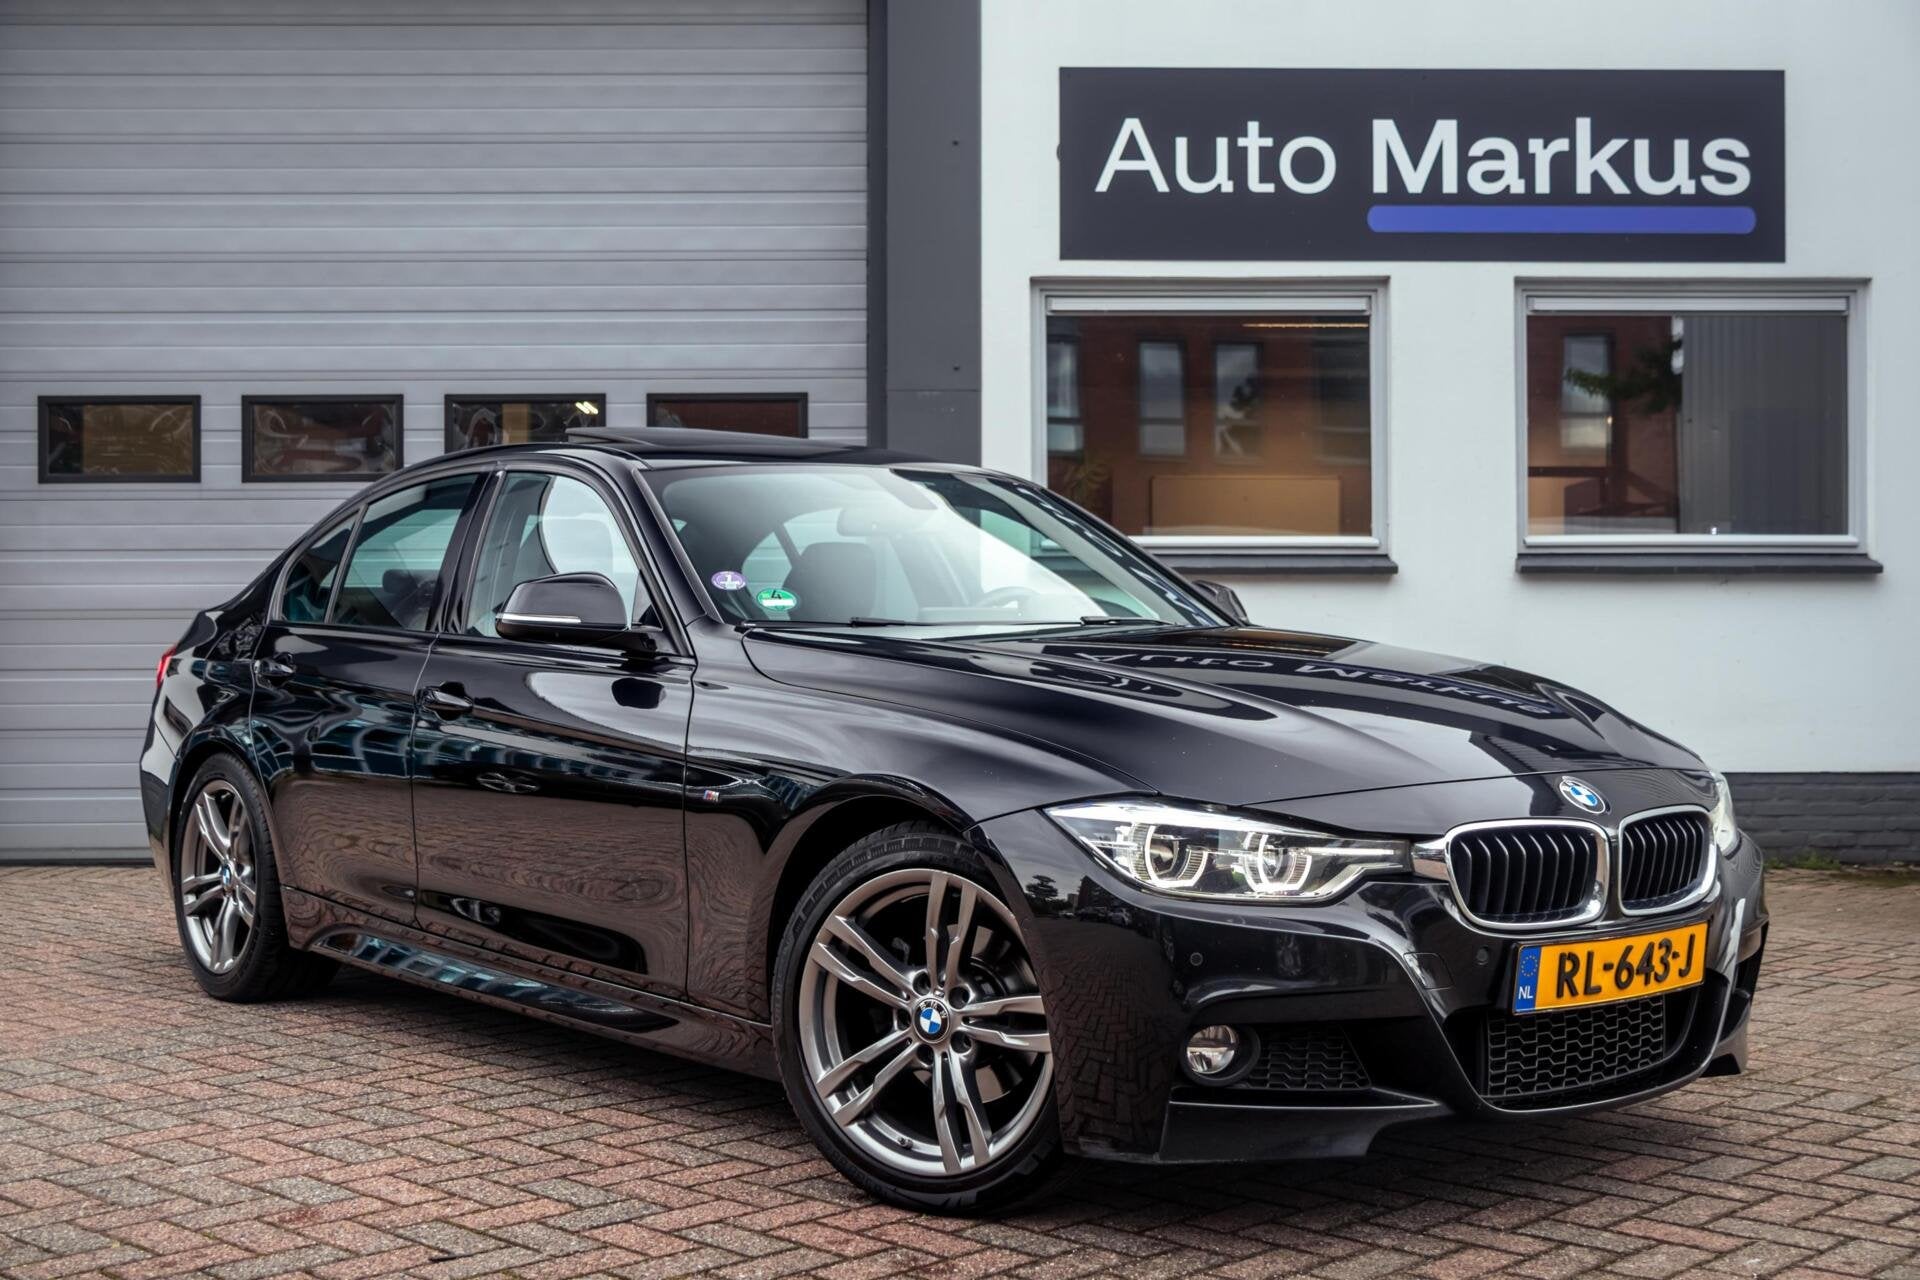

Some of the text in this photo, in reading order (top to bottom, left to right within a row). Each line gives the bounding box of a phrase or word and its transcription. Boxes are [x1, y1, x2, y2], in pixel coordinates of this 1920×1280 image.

[1095, 116, 1752, 196] Auto Markus
[1518, 985, 1534, 1000] NL
[1556, 933, 1696, 998] RL-643-J
